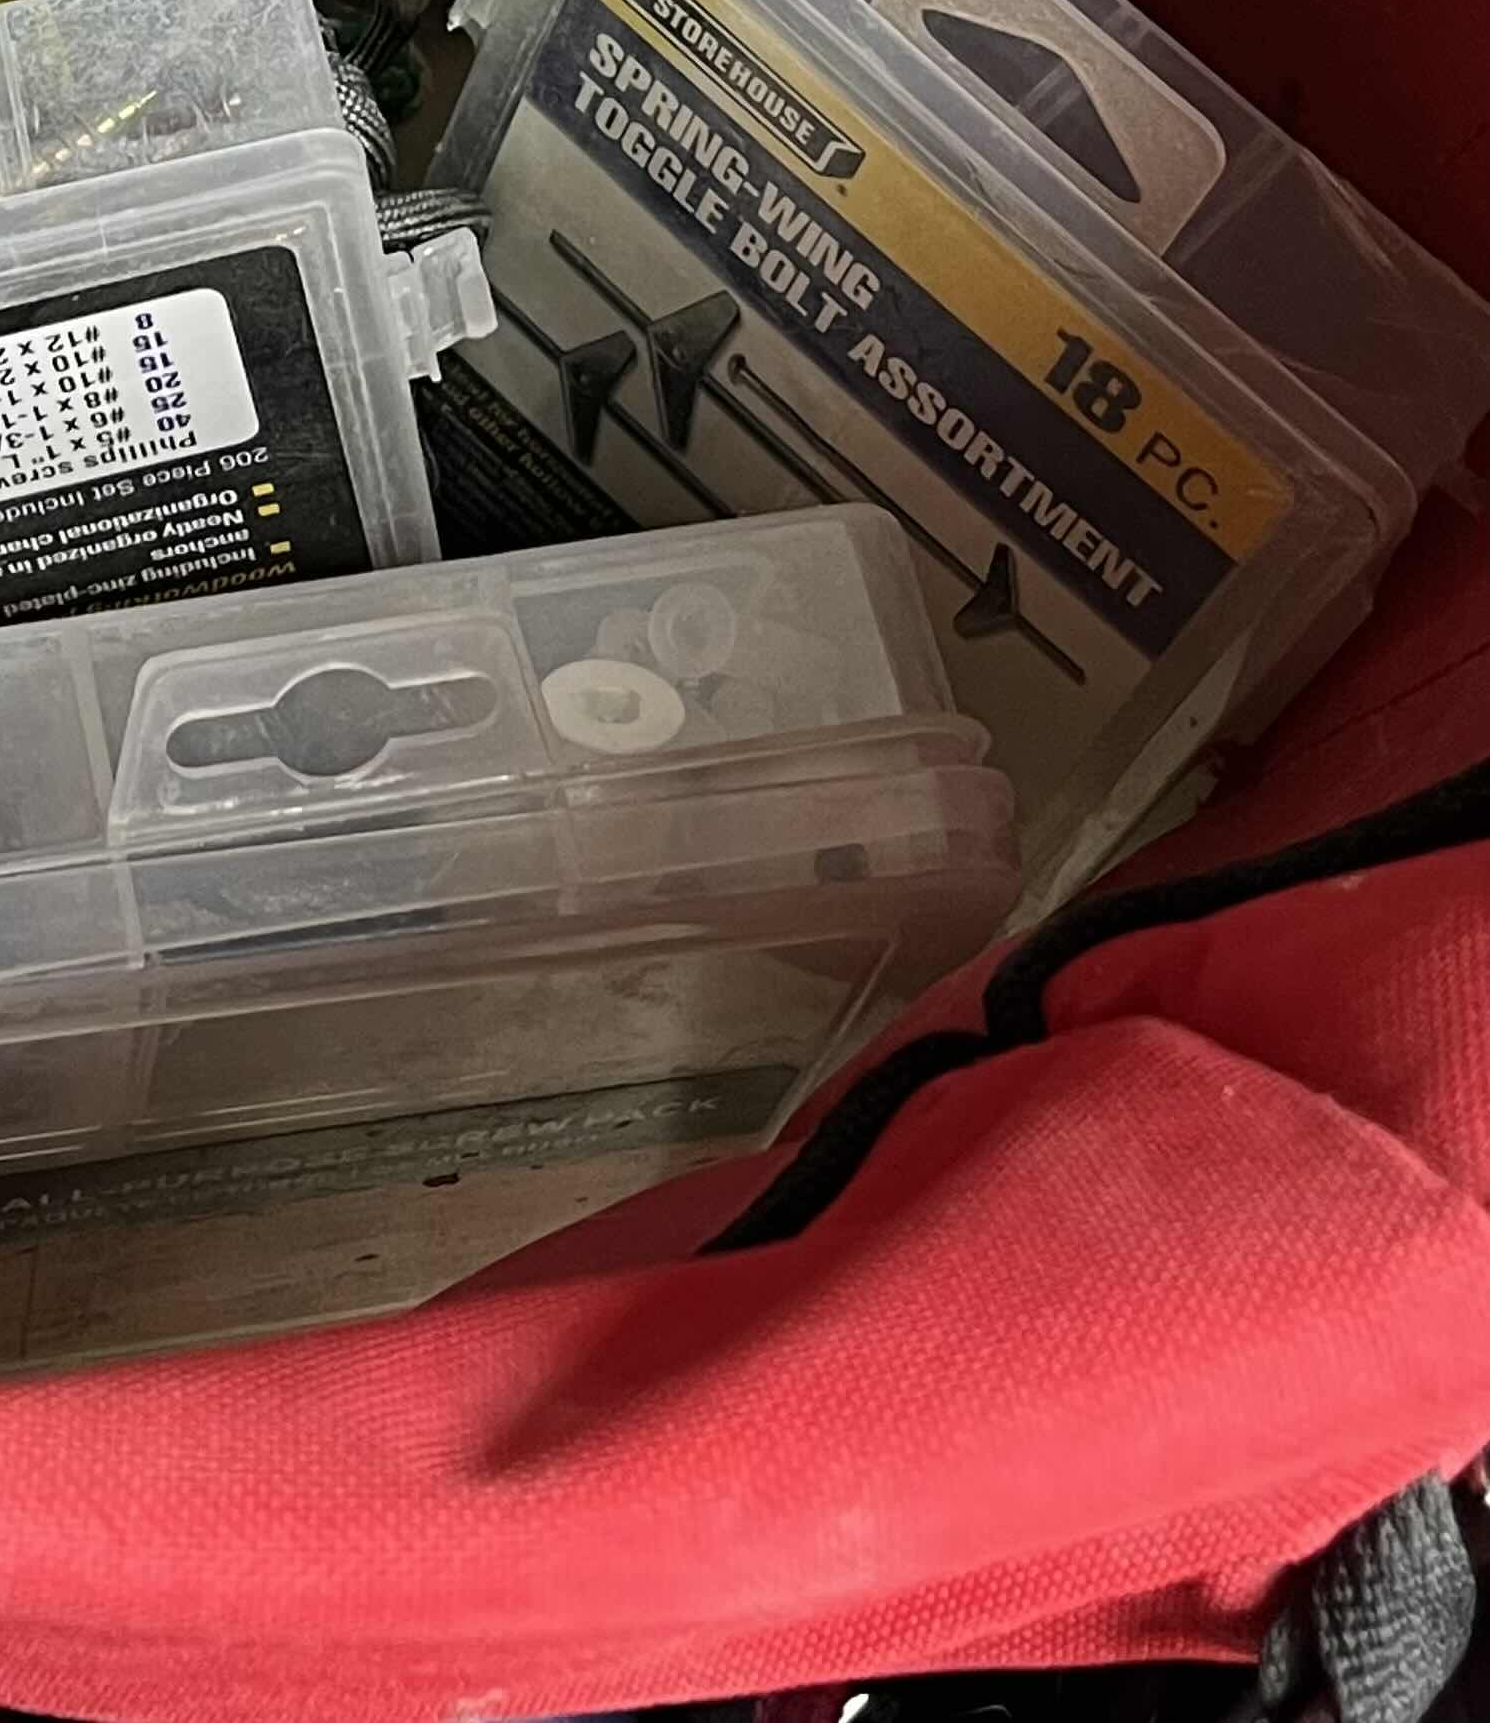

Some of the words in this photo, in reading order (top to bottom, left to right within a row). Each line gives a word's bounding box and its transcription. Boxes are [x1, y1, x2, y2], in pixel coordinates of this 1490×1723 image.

[589, 33, 881, 310] SPRING-WING
[134, 312, 155, 331] 8
[44, 324, 100, 354] #12
[131, 330, 168, 353] 15
[575, 71, 730, 234] TOGGLE
[730, 220, 848, 333] BOLT
[848, 335, 1163, 608] ASSORTMENT
[51, 344, 107, 374] #10
[138, 351, 174, 375] 15
[57, 365, 112, 394] #10
[144, 370, 182, 394] 20
[82, 386, 119, 410] #8
[150, 390, 188, 414] 25
[89, 405, 126, 429] #6
[155, 413, 192, 433] 40
[1043, 327, 1144, 435] 18
[1136, 432, 1221, 529] PC.
[82, 429, 198, 469] Phillips
[95, 425, 132, 448] #5
[1, 452, 22, 470] L
[218, 445, 270, 472] 206
[141, 459, 212, 488] Piece
[91, 478, 136, 502] Set
[57, 488, 239, 546] Organizational
[161, 508, 245, 539] Neatly
[37, 529, 159, 572] organized
[149, 527, 250, 562] anchors
[6, 559, 34, 575] in
[140, 546, 257, 583] Including
[2, 573, 137, 618] zinc-plated
